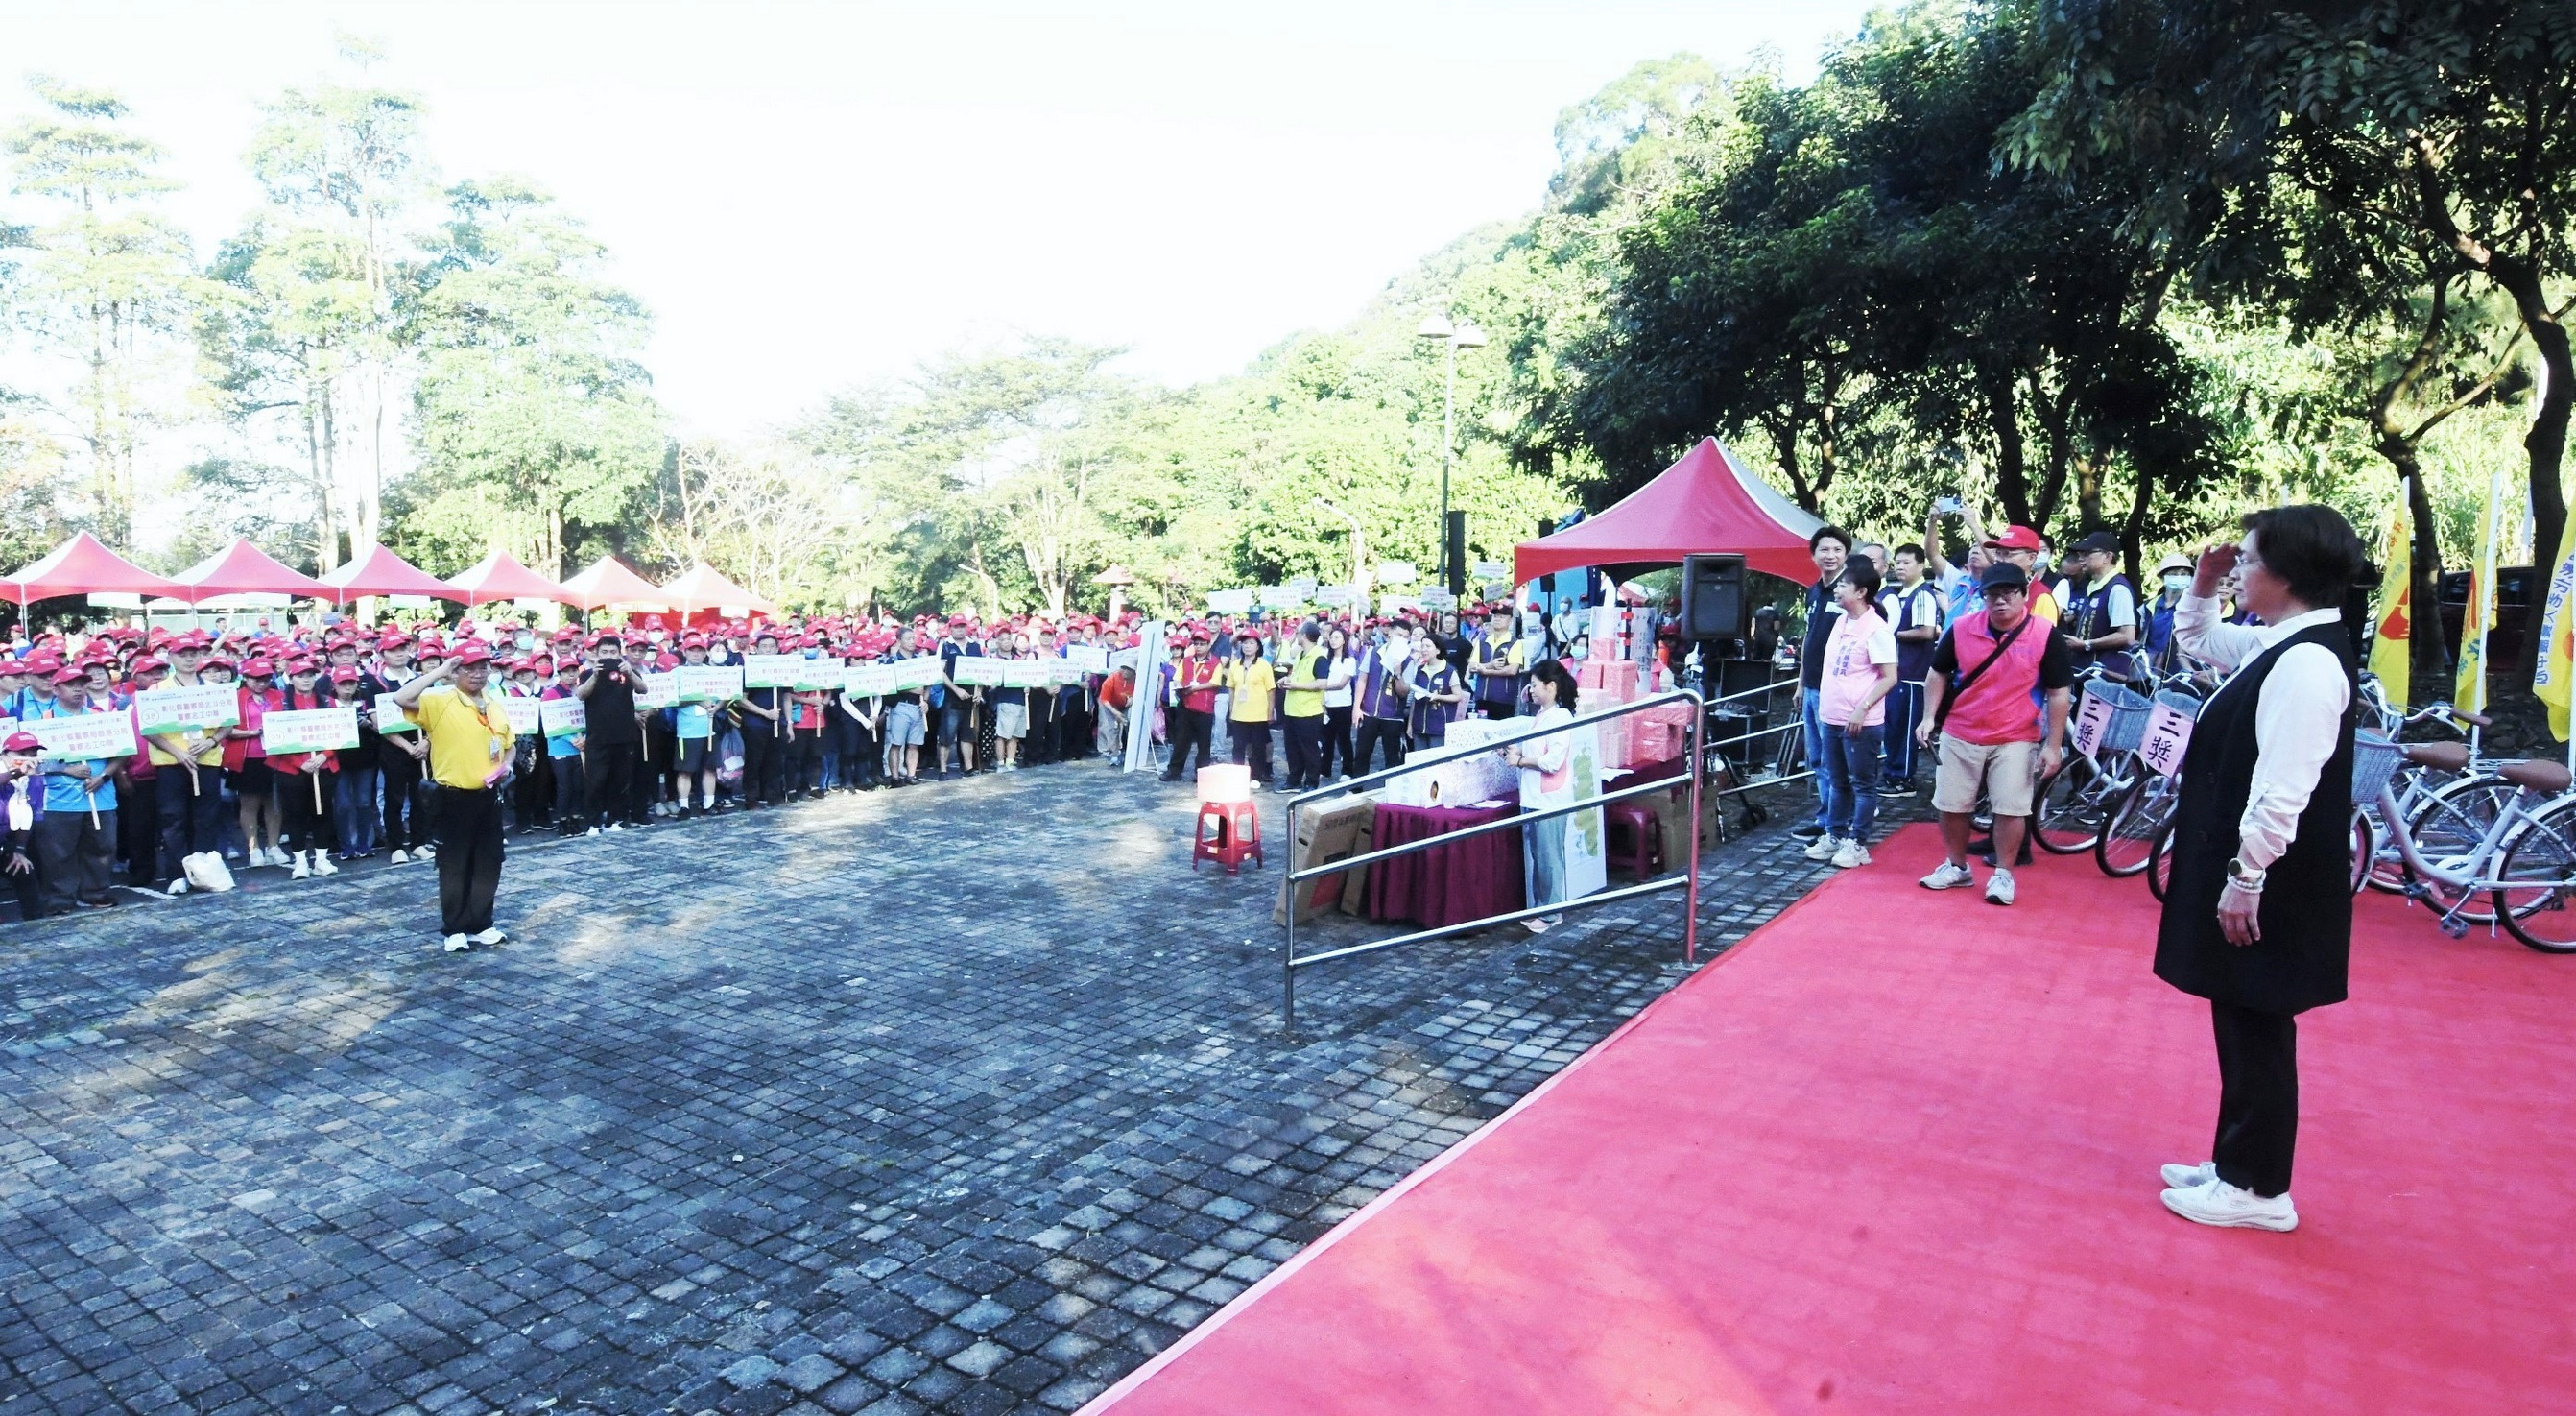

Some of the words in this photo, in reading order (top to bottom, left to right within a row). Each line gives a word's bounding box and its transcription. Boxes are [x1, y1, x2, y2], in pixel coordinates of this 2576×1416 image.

[145, 712, 156, 721] 38
[2077, 698, 2101, 752] 三獎
[2147, 710, 2182, 769] 三獎
